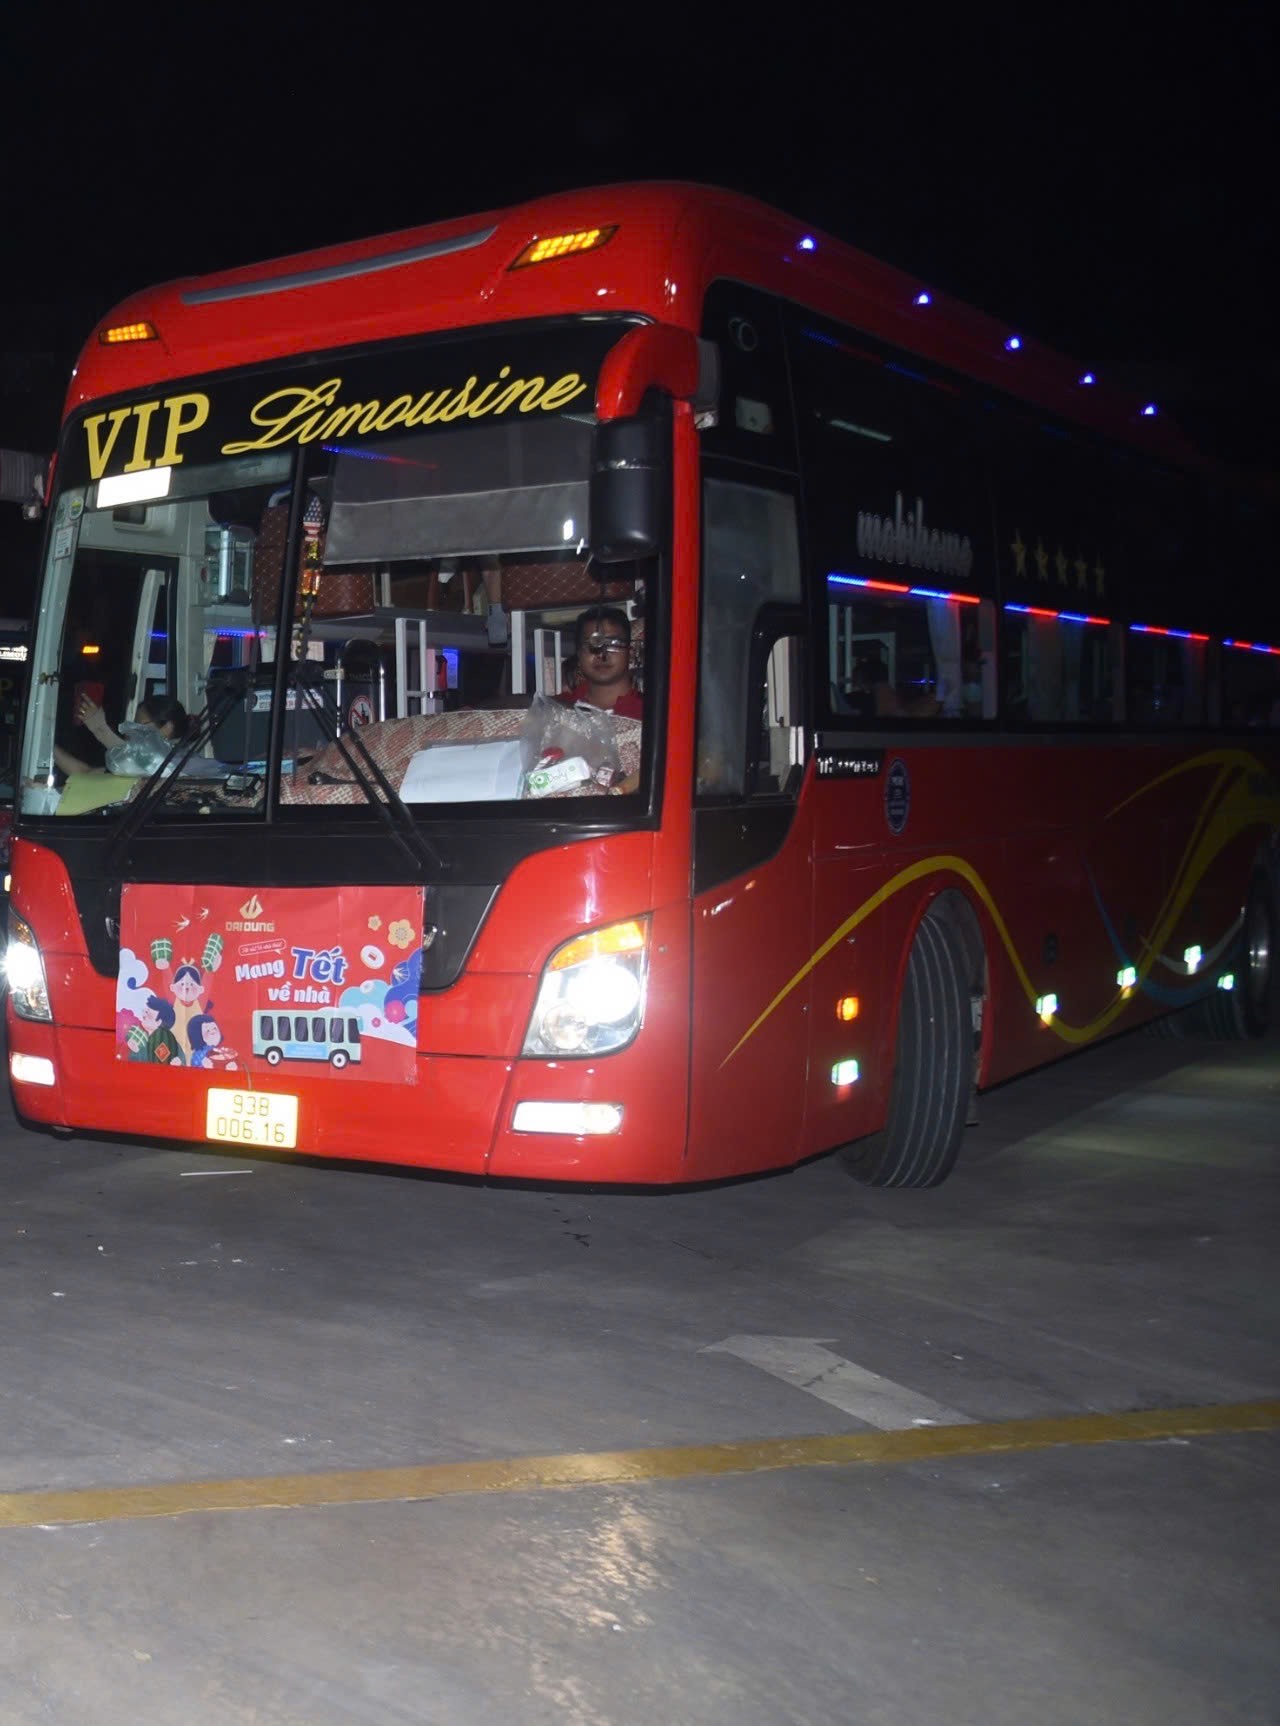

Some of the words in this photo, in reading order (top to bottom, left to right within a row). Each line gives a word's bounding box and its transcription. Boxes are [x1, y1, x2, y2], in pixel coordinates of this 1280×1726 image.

[83, 393, 210, 480] VIP
[220, 366, 587, 454] Limousine
[235, 959, 285, 982] Mang
[291, 946, 348, 985] Tết
[267, 981, 292, 1002] về
[293, 986, 330, 1004] nhà
[233, 1094, 270, 1117] 93B
[217, 1117, 285, 1143] 006.16
